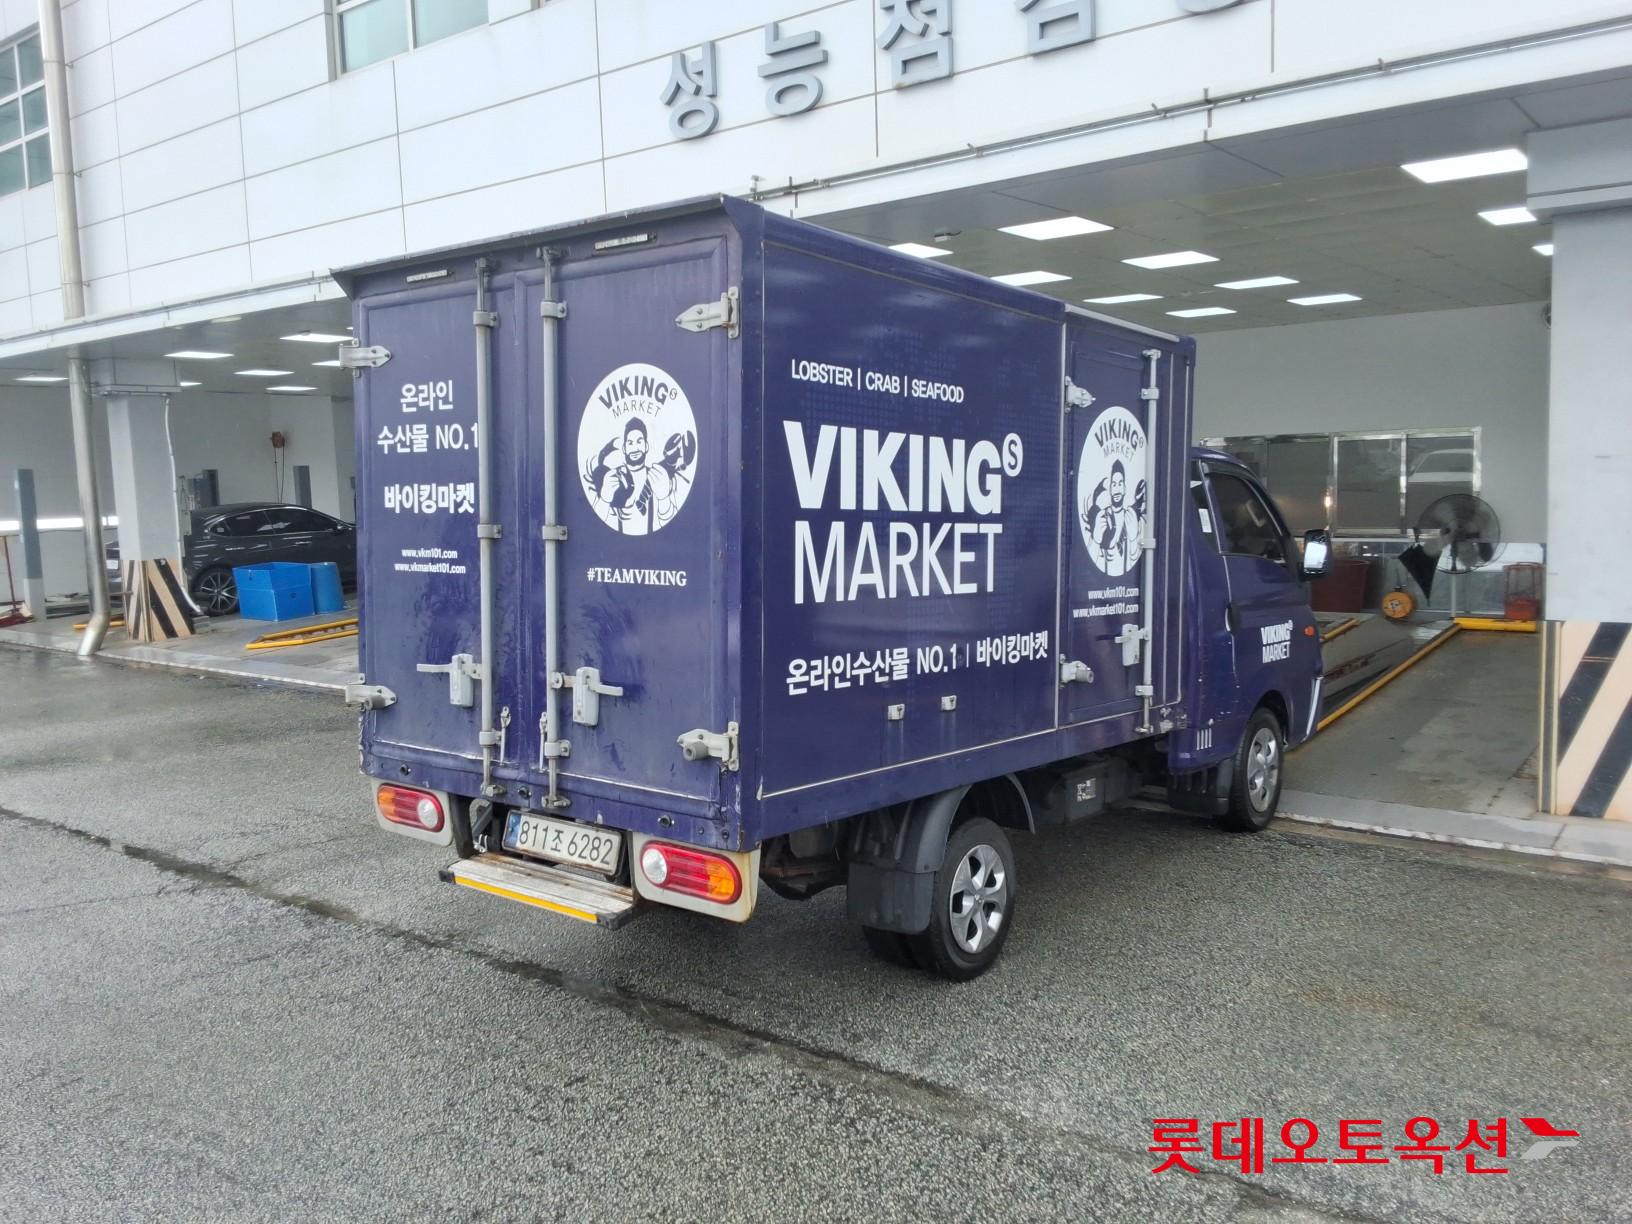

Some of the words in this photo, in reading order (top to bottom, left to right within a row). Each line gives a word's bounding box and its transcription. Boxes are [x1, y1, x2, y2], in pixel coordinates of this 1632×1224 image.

[400, 379, 454, 412] 온라인
[791, 359, 853, 387] LOBSTER
[865, 371, 900, 394] CRAB
[911, 378, 965, 403] SEAFOOD
[612, 400, 661, 419] MARKET
[377, 424, 429, 454] 수산물
[436, 422, 478, 450] NO.1
[1103, 441, 1135, 463] MARKET
[384, 482, 475, 514] 바이킹마켓
[394, 562, 467, 574] www.vkmarket101.com
[401, 547, 458, 559] www.vkm101.com
[794, 520, 1003, 604] MARKET
[587, 566, 688, 587] #TEAMVIKING
[786, 647, 910, 696] 온라인수산물
[916, 643, 958, 675] NO.1
[976, 630, 1049, 667] 바이킹마켓
[1262, 641, 1291, 664] MARKET
[519, 821, 564, 852] 811조
[567, 831, 614, 865] 6282
